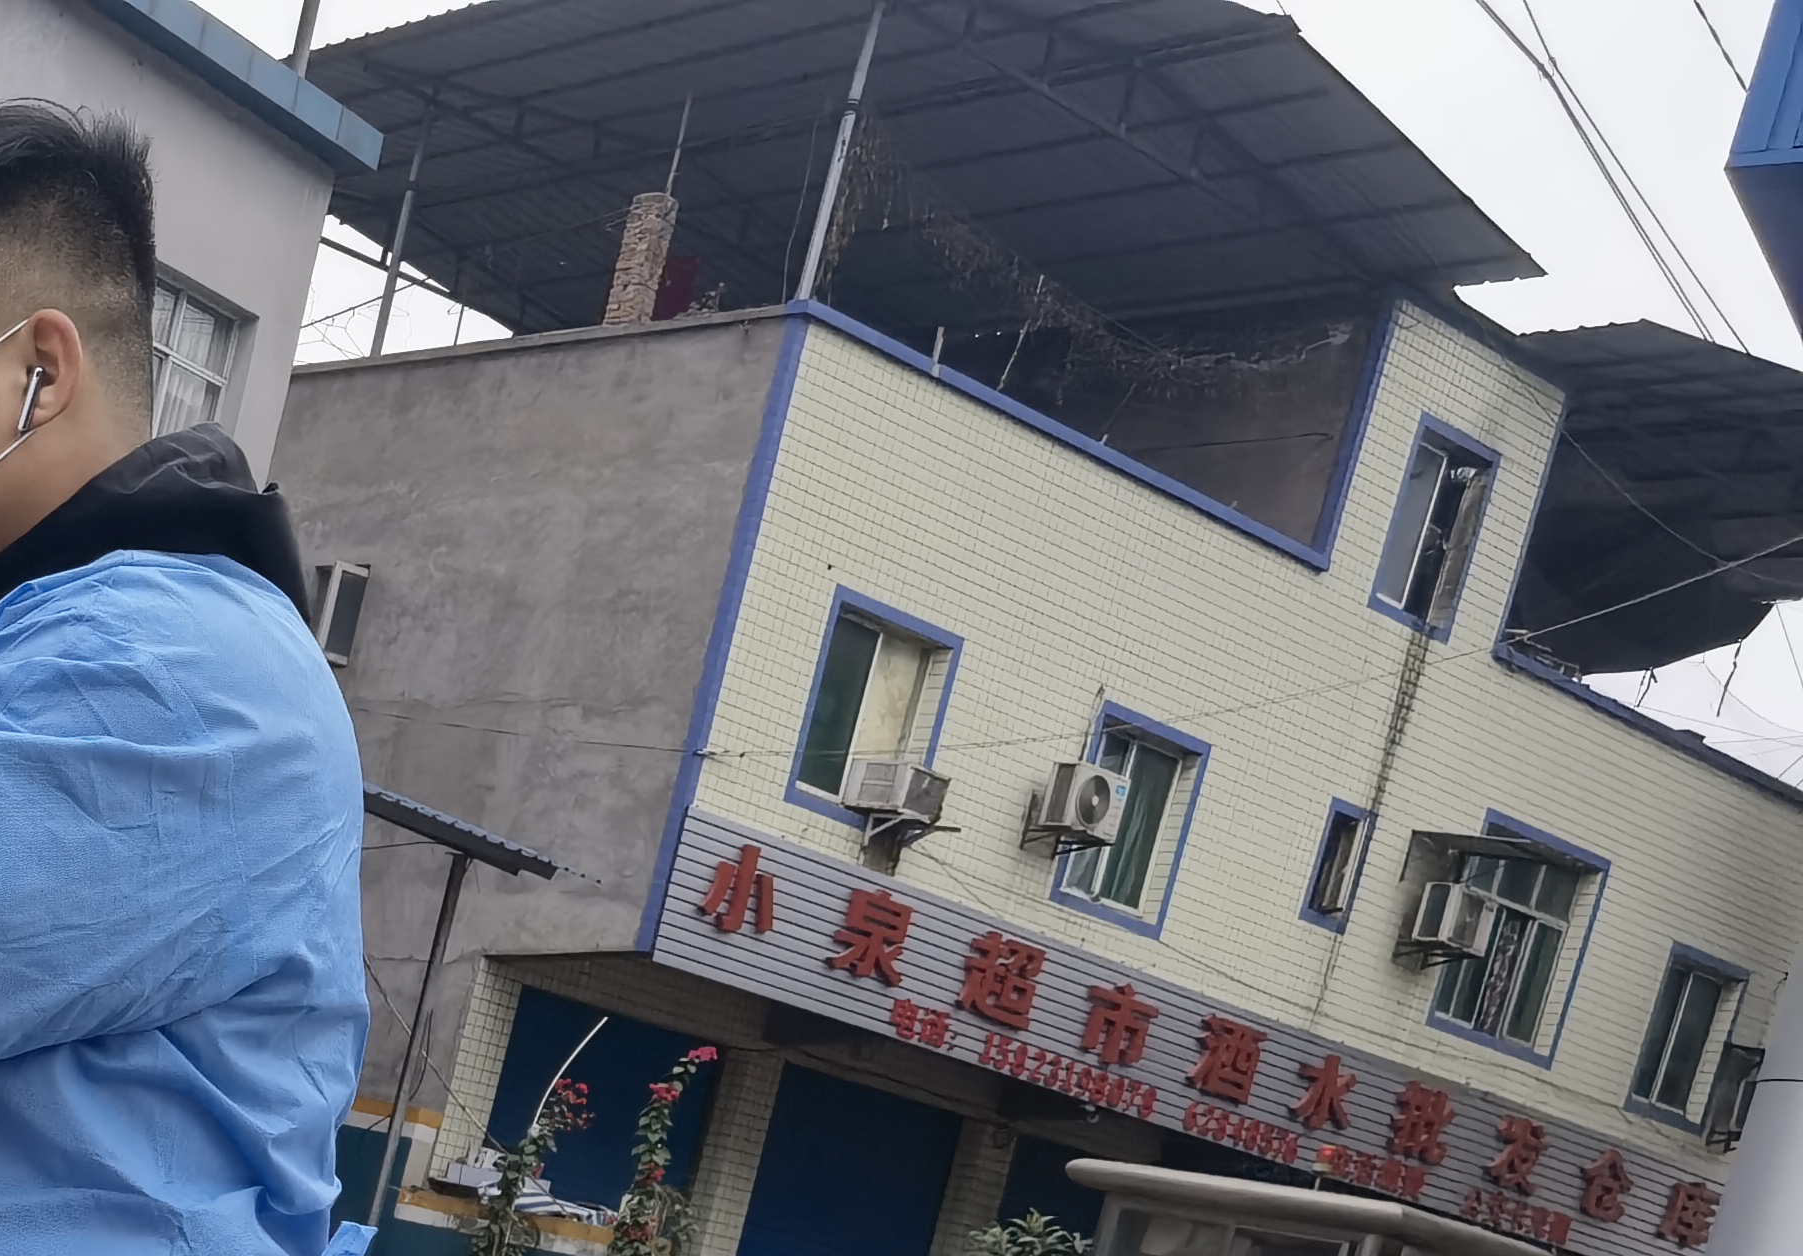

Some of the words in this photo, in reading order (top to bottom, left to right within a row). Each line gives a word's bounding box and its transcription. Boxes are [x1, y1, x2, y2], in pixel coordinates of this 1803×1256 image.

[697, 843, 1722, 1250] 小泉超市酒水批发仓库
